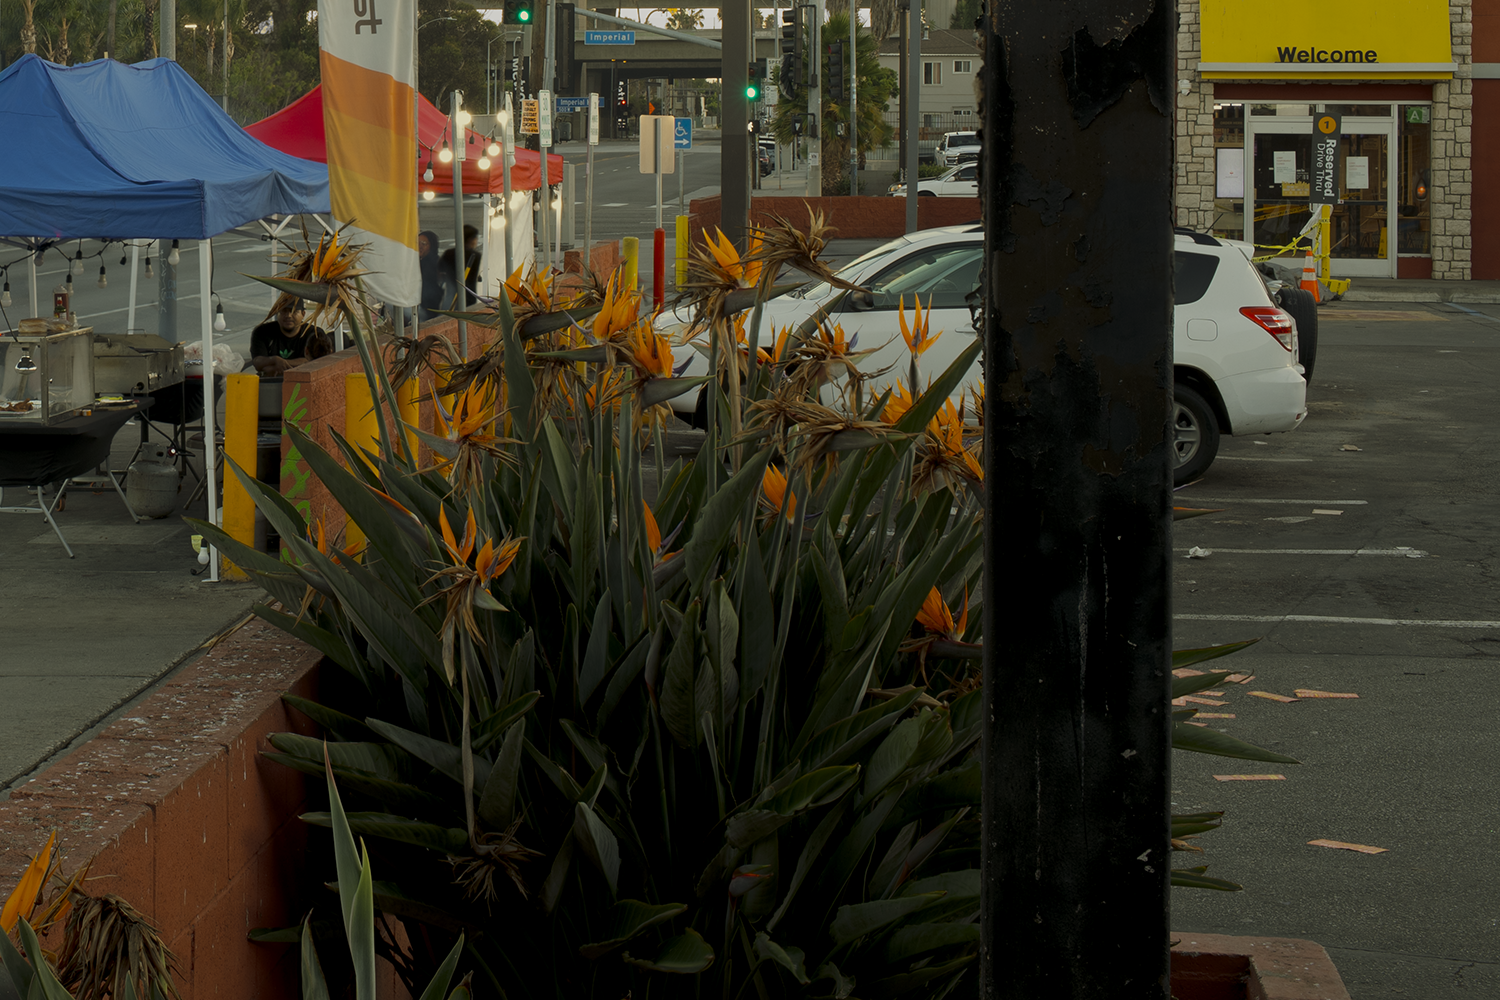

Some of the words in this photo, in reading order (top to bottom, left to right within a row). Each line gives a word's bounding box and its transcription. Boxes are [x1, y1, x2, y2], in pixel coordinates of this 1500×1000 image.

[590, 33, 630, 42] Imperial
[1276, 46, 1378, 64] Welcome
[560, 98, 585, 107] Imperial
[1409, 110, 1420, 120] A
[1315, 143, 1326, 168] Drive
[1325, 138, 1337, 197] Reserved
[1315, 169, 1325, 193] Thru
